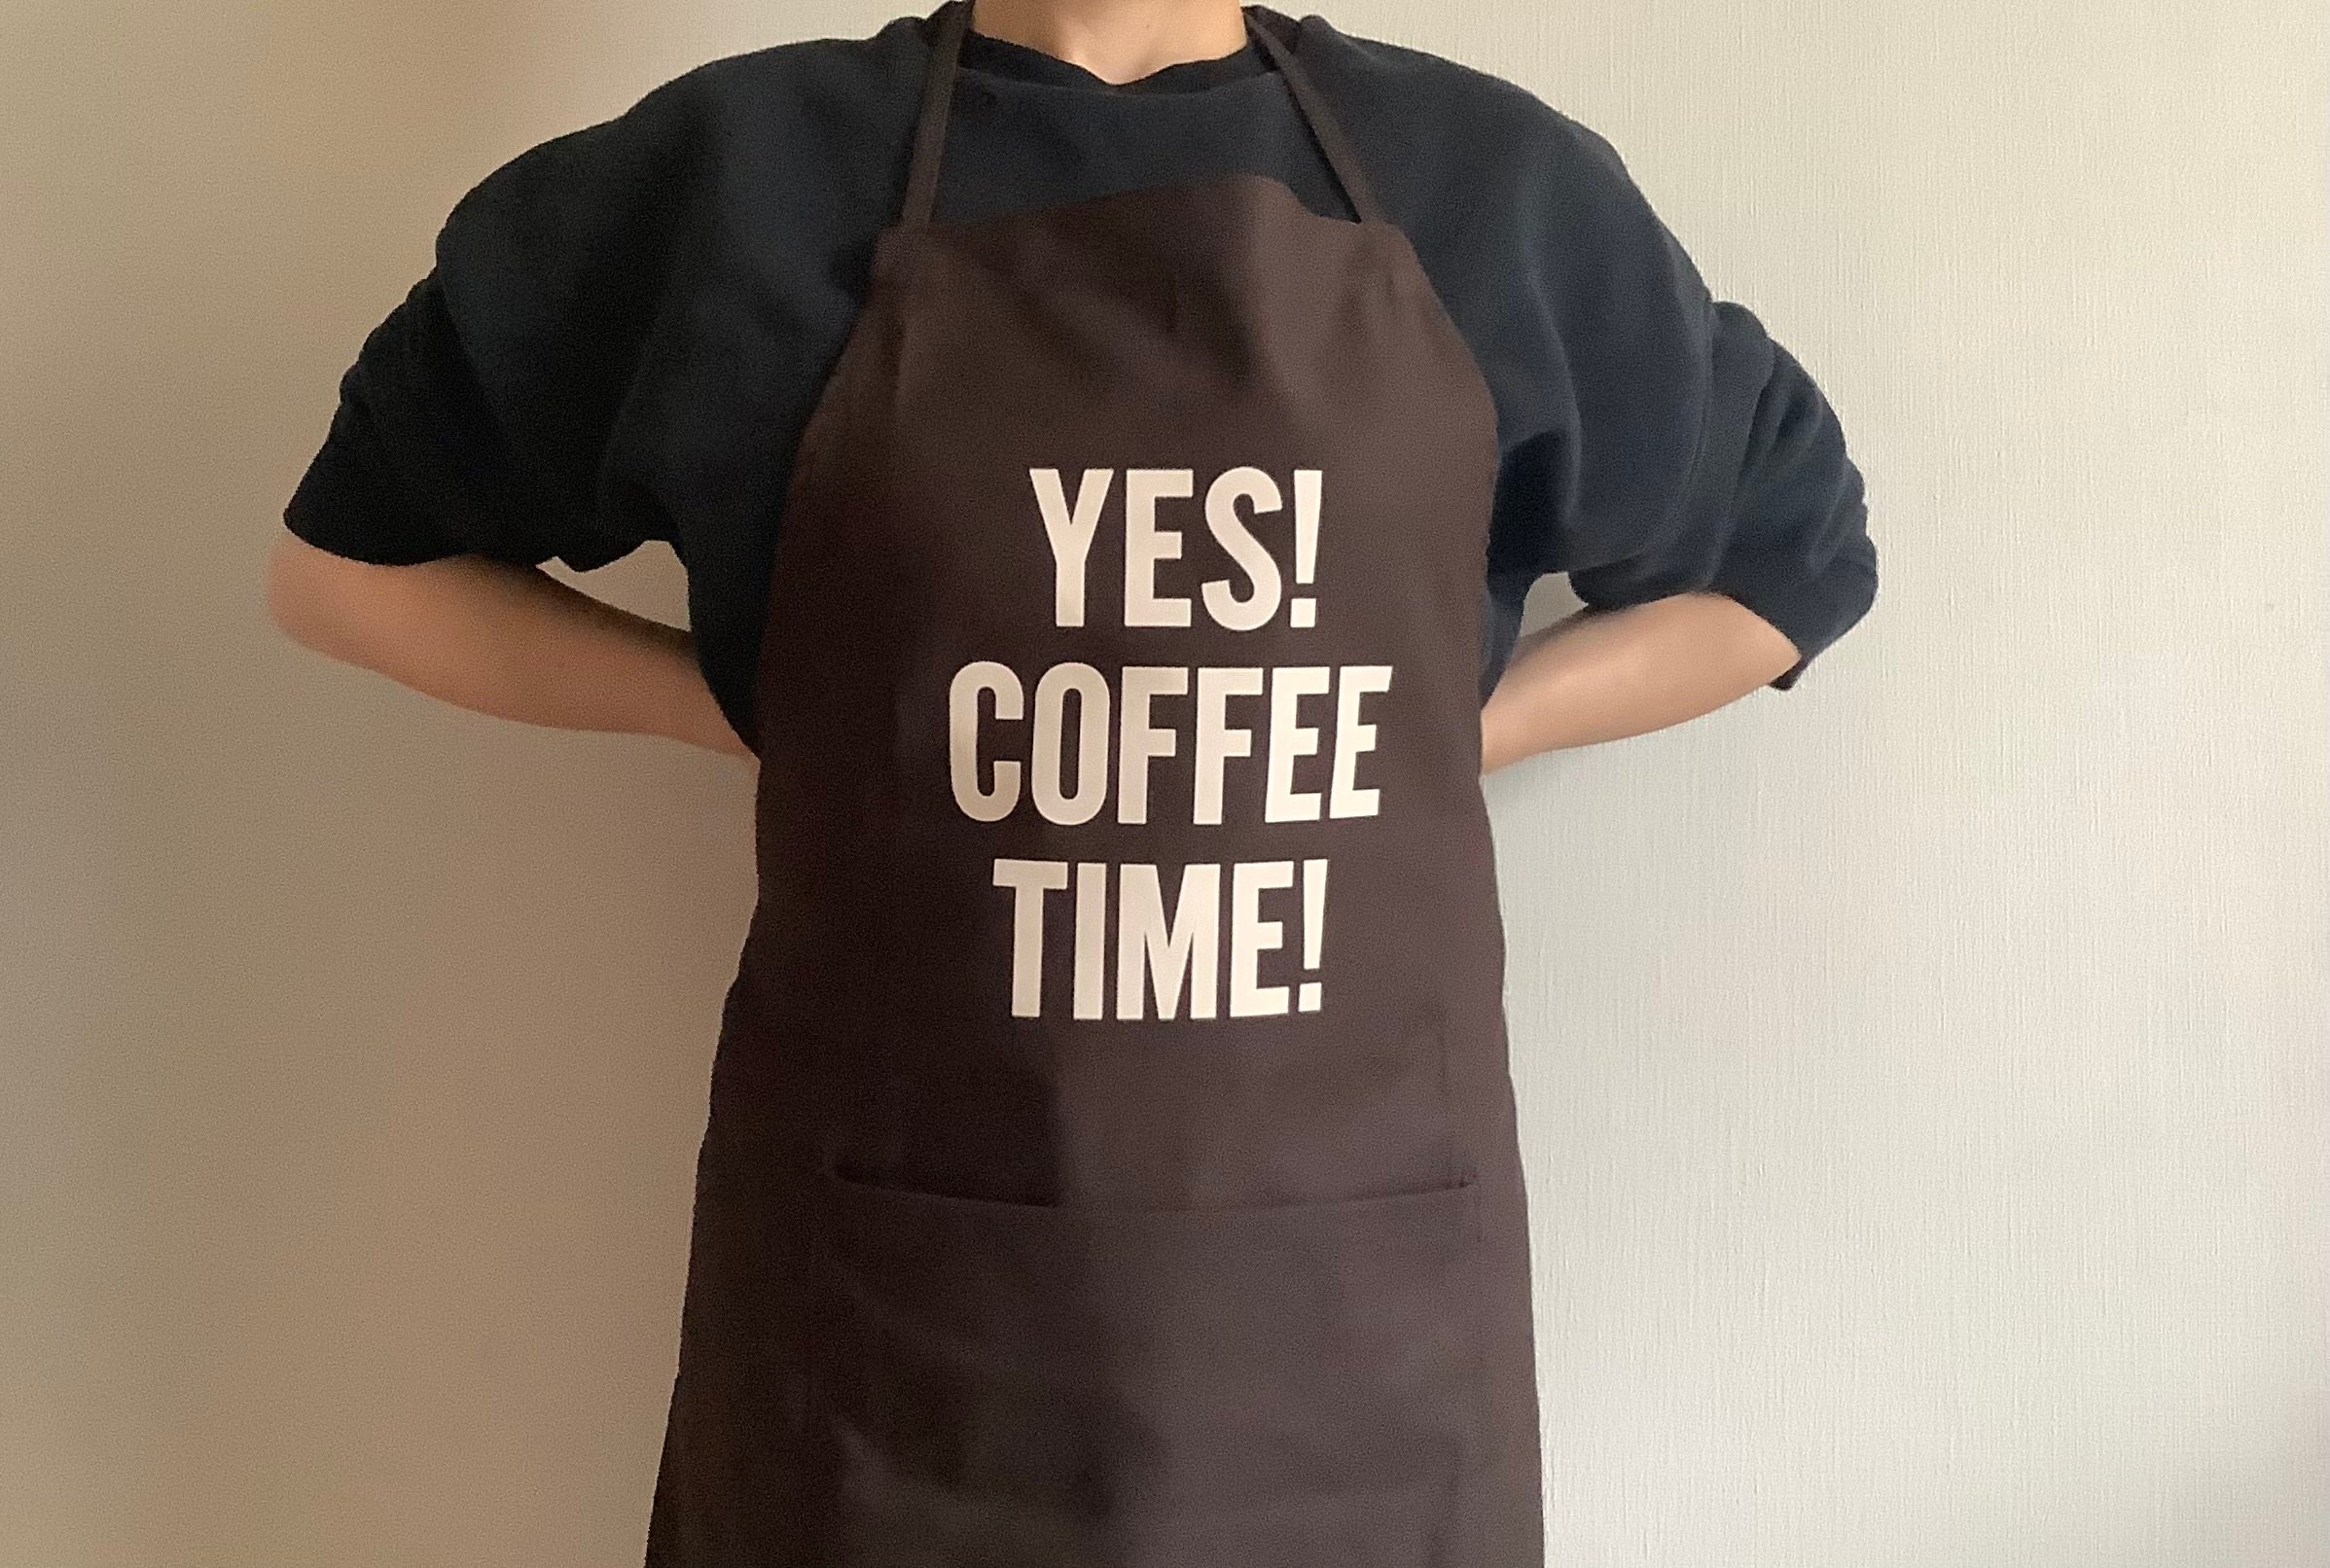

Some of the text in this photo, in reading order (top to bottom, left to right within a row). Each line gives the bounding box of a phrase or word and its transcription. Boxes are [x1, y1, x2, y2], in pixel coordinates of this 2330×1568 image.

[1029, 467, 1323, 630] YES!
[949, 661, 1394, 825] COFFEE
[993, 859, 1330, 1020] TIME!
